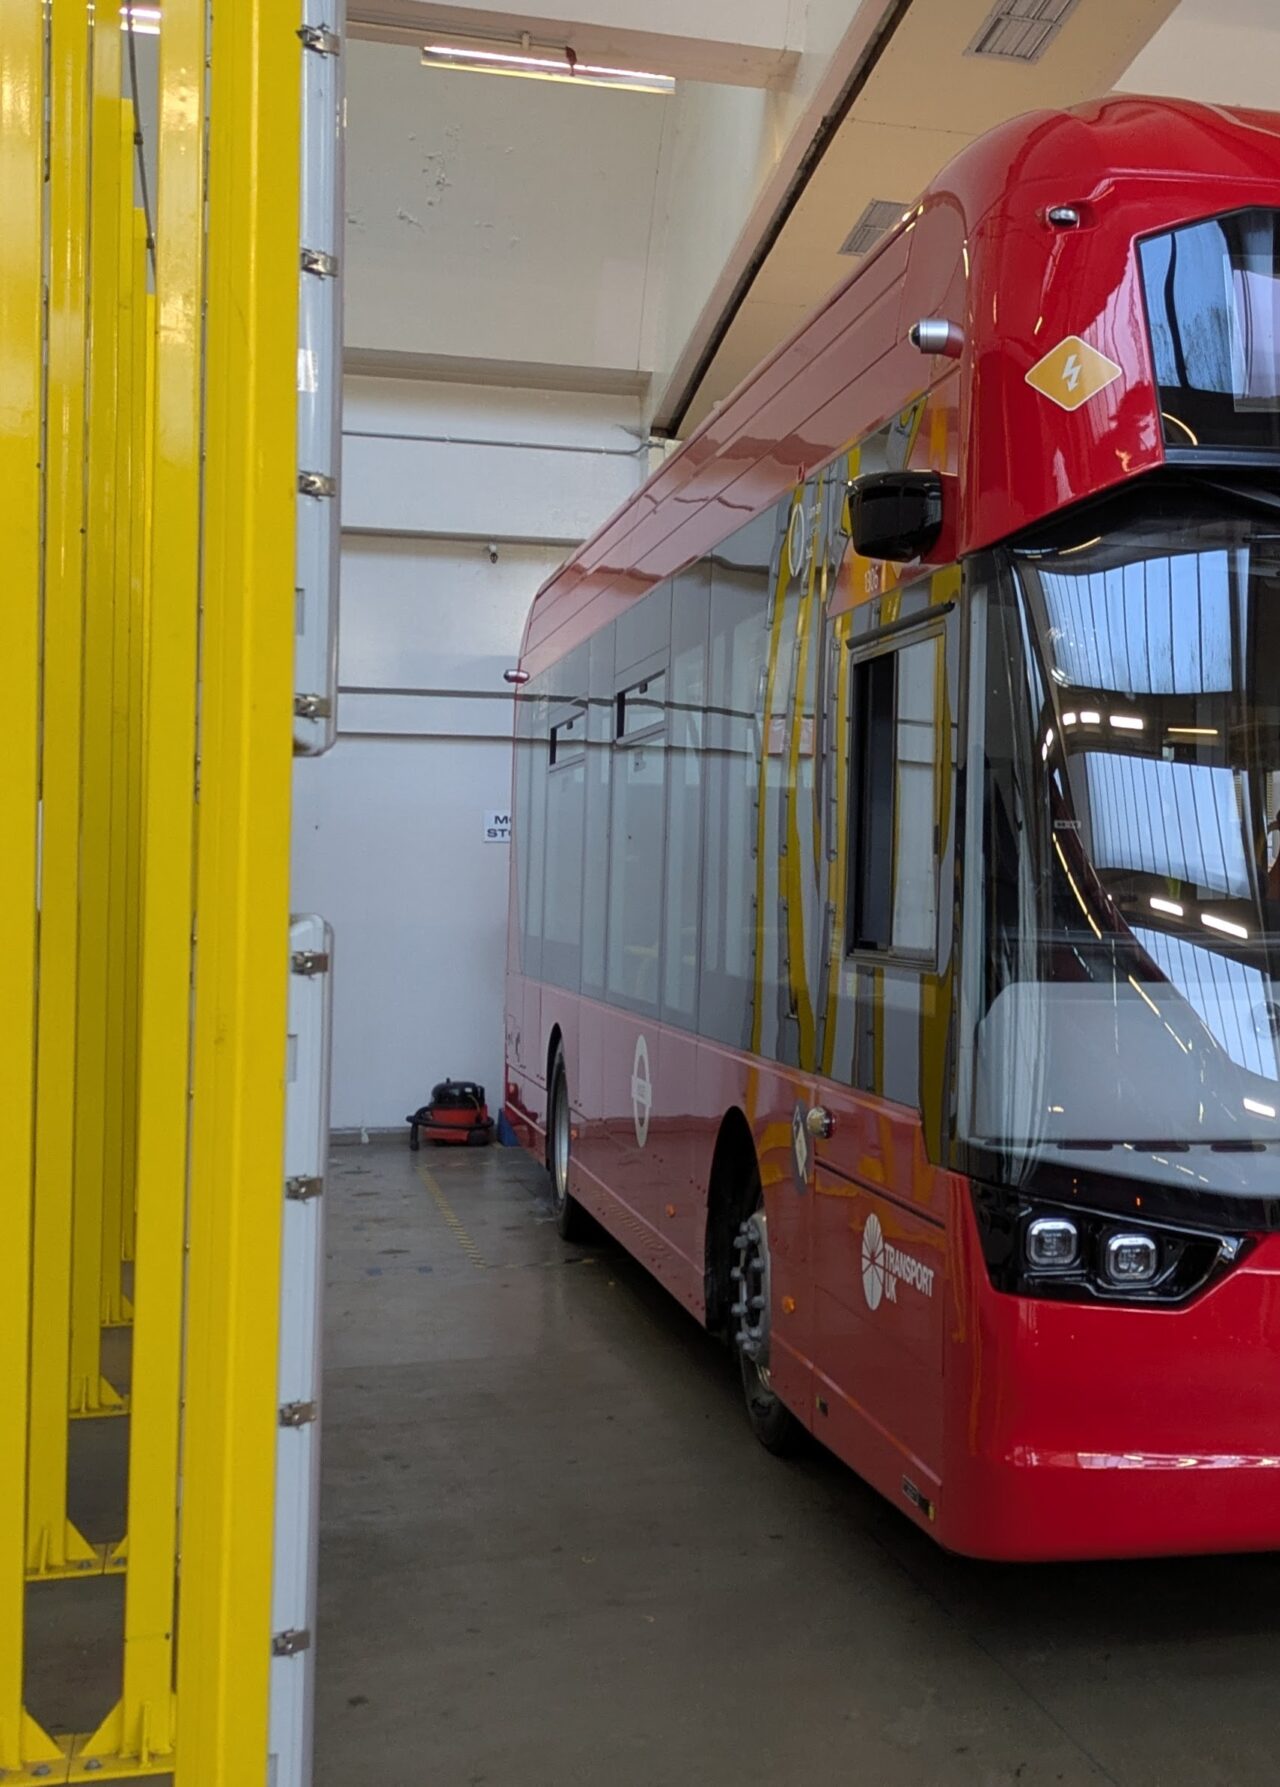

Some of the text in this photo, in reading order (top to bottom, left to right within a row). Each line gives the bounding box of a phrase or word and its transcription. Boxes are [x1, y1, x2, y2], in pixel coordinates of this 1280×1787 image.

[494, 815, 511, 825] M
[884, 1242, 934, 1298] TRANSPORT
[885, 1271, 897, 1304] UK
